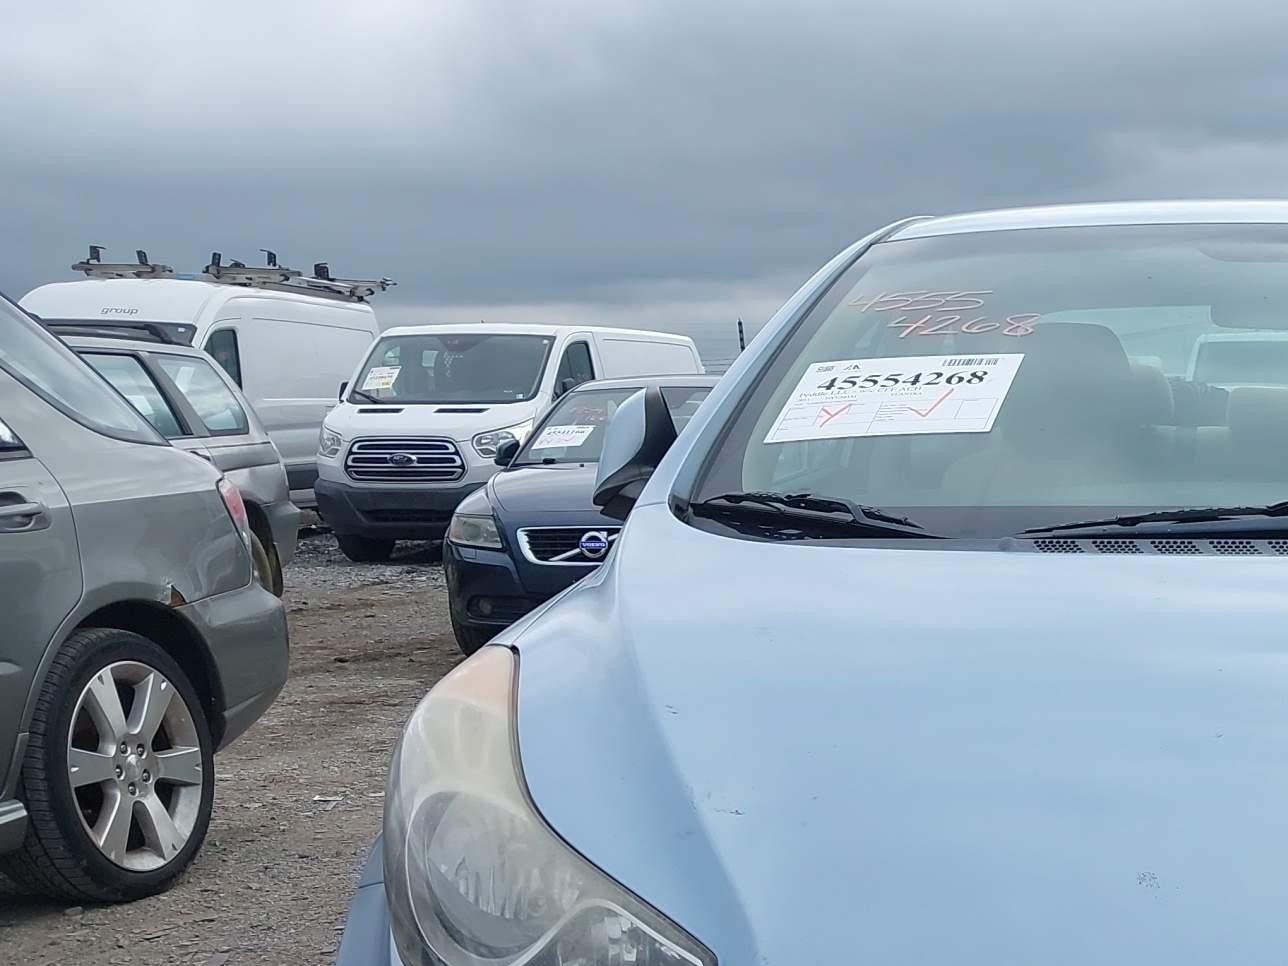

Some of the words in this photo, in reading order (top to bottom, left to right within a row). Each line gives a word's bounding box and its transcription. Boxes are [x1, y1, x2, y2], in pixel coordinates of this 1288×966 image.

[99, 307, 139, 316] group
[847, 290, 993, 312] 4555
[888, 313, 1041, 338] 4268
[816, 370, 989, 391] 45554268
